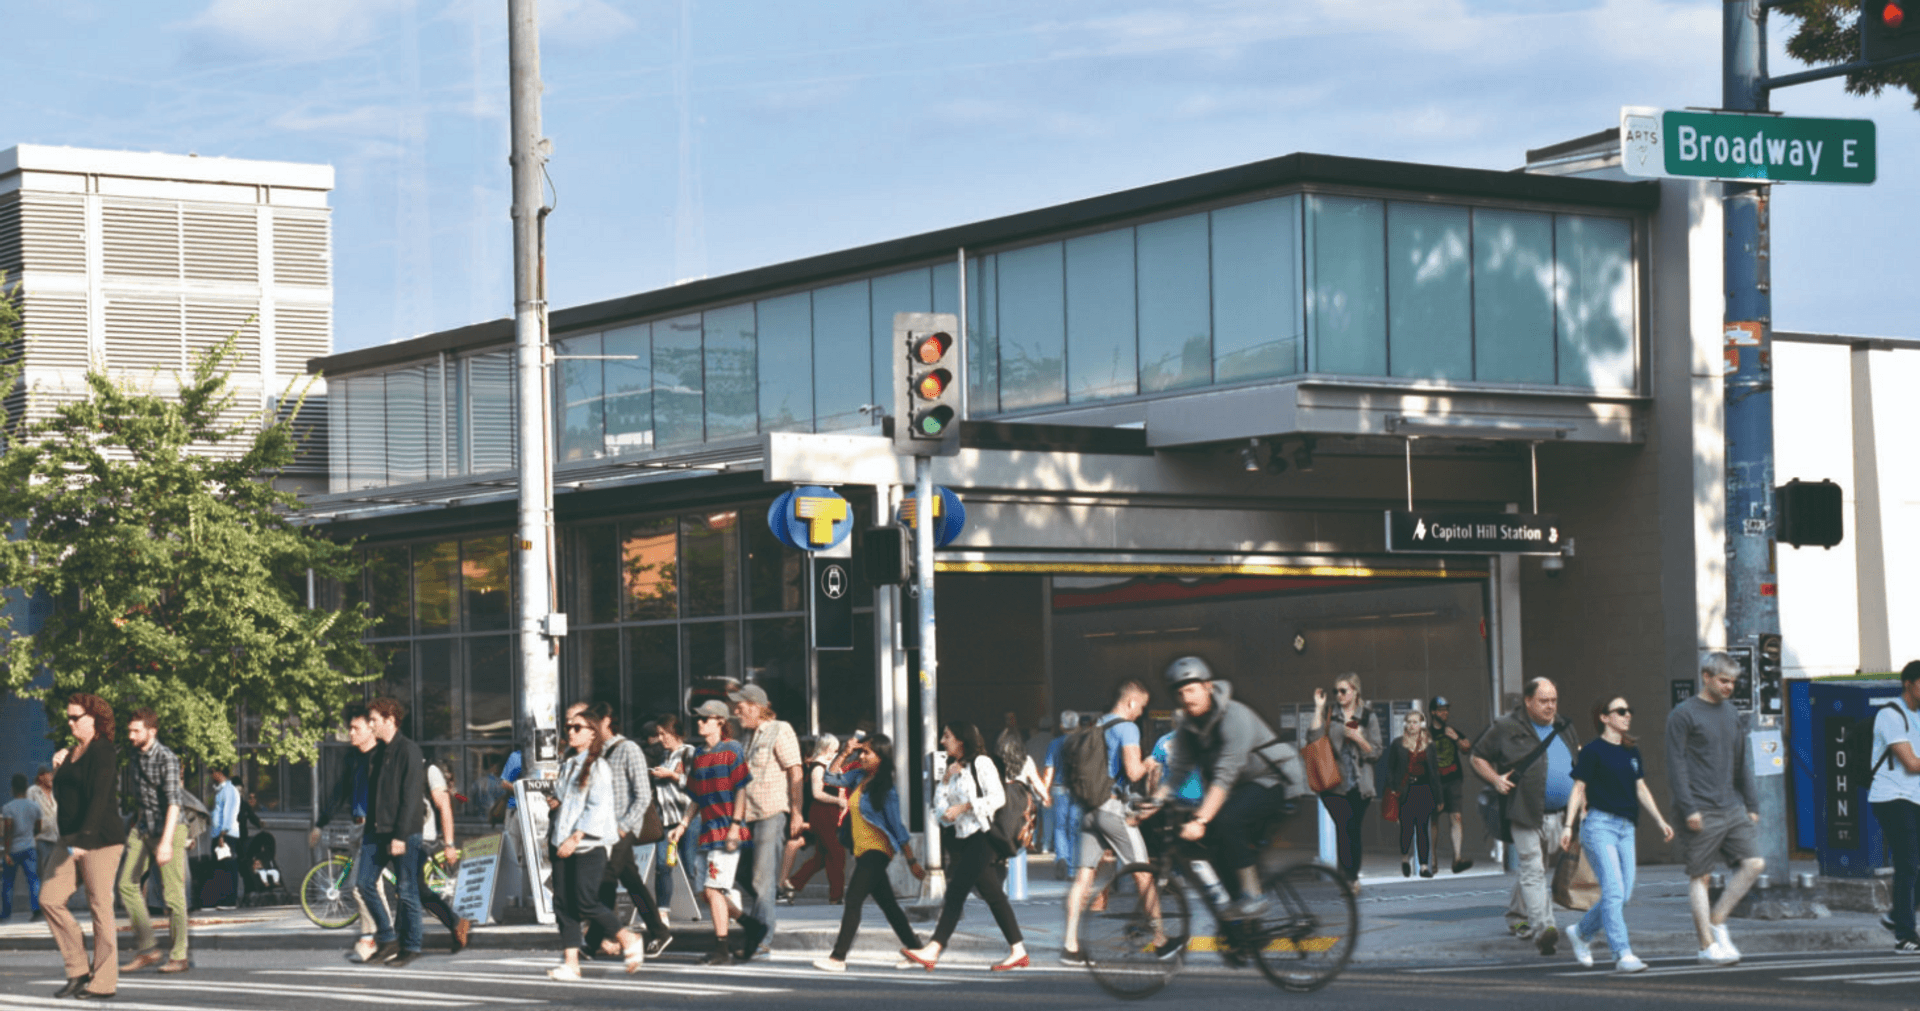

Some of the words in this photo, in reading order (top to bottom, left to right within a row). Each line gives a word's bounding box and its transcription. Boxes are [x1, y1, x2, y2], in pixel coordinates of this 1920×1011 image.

[1626, 130, 1658, 145] ARTS
[1678, 125, 1823, 176] Broadway
[1842, 139, 1859, 168] E
[1431, 523, 1473, 542] Capitol
[1476, 524, 1497, 539] Hill
[1500, 524, 1542, 541] Station
[1835, 726, 1849, 817] JOHN
[528, 780, 550, 789] NOW
